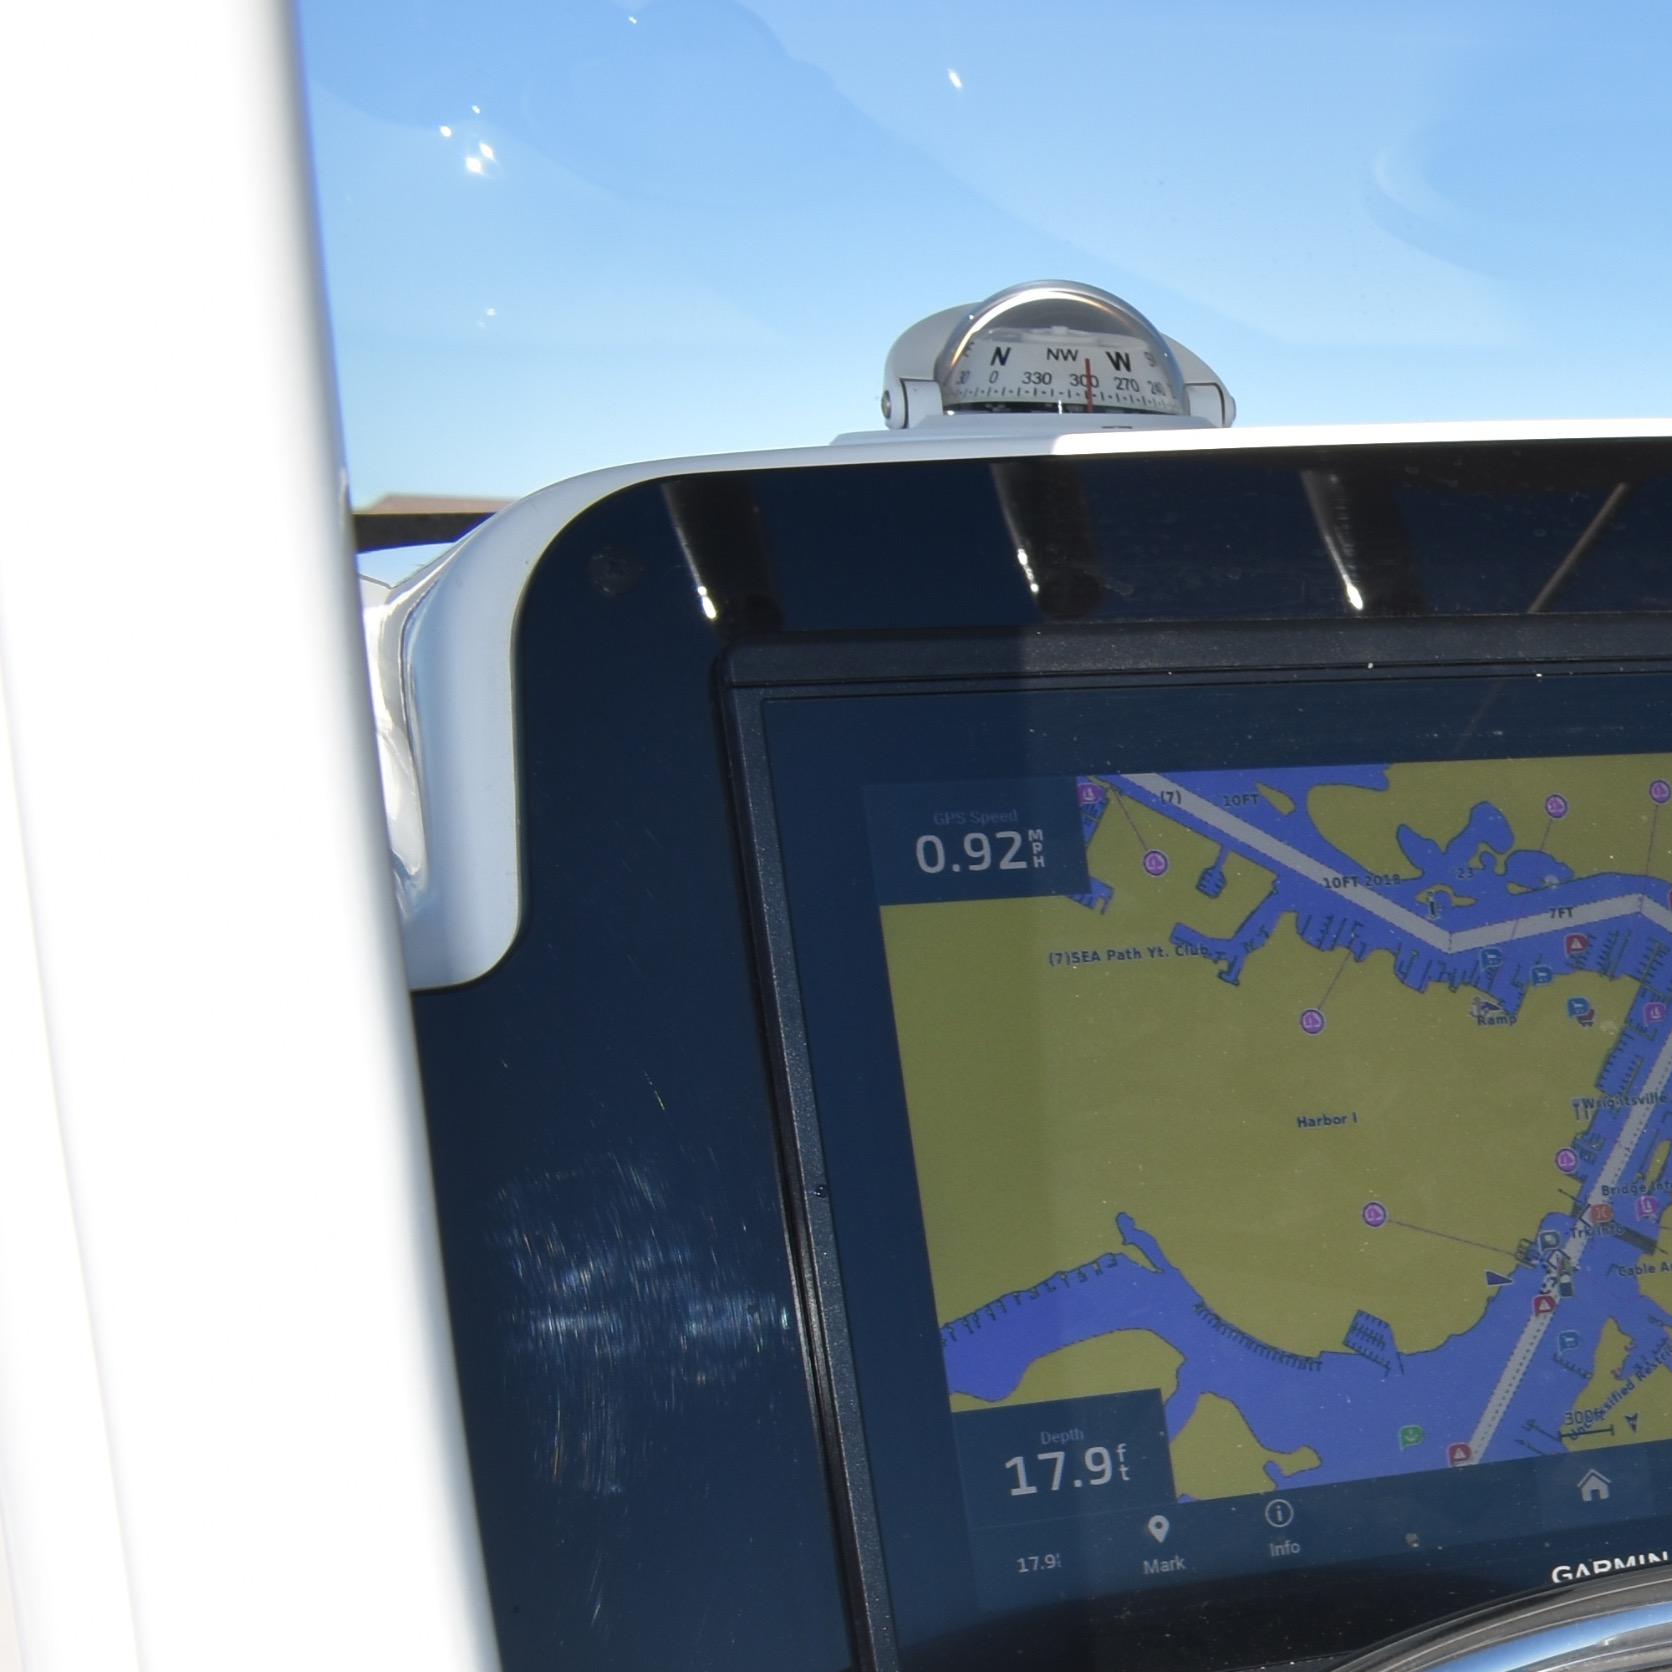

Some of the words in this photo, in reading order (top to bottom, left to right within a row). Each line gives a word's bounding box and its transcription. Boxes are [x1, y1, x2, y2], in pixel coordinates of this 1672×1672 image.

[990, 346, 1012, 367] N
[1046, 346, 1080, 363] NW
[1105, 350, 1132, 373] W
[1022, 371, 1053, 386] 330
[1069, 372, 1101, 389] 300
[1113, 376, 1140, 393] 270
[915, 830, 1028, 874] 0.92
[1323, 875, 1359, 889] 10FT
[1549, 906, 1574, 919] 7FT
[1106, 947, 1142, 961] Path
[1174, 942, 1209, 958] Club
[1477, 1012, 1518, 1027] Ramp
[1296, 1112, 1348, 1129] Harbor
[1601, 1182, 1647, 1198] Bridge
[1039, 1426, 1085, 1446] Depth
[1003, 1446, 1113, 1497] 17.9
[1269, 1539, 1302, 1560] Info
[1142, 1554, 1188, 1577] Mark
